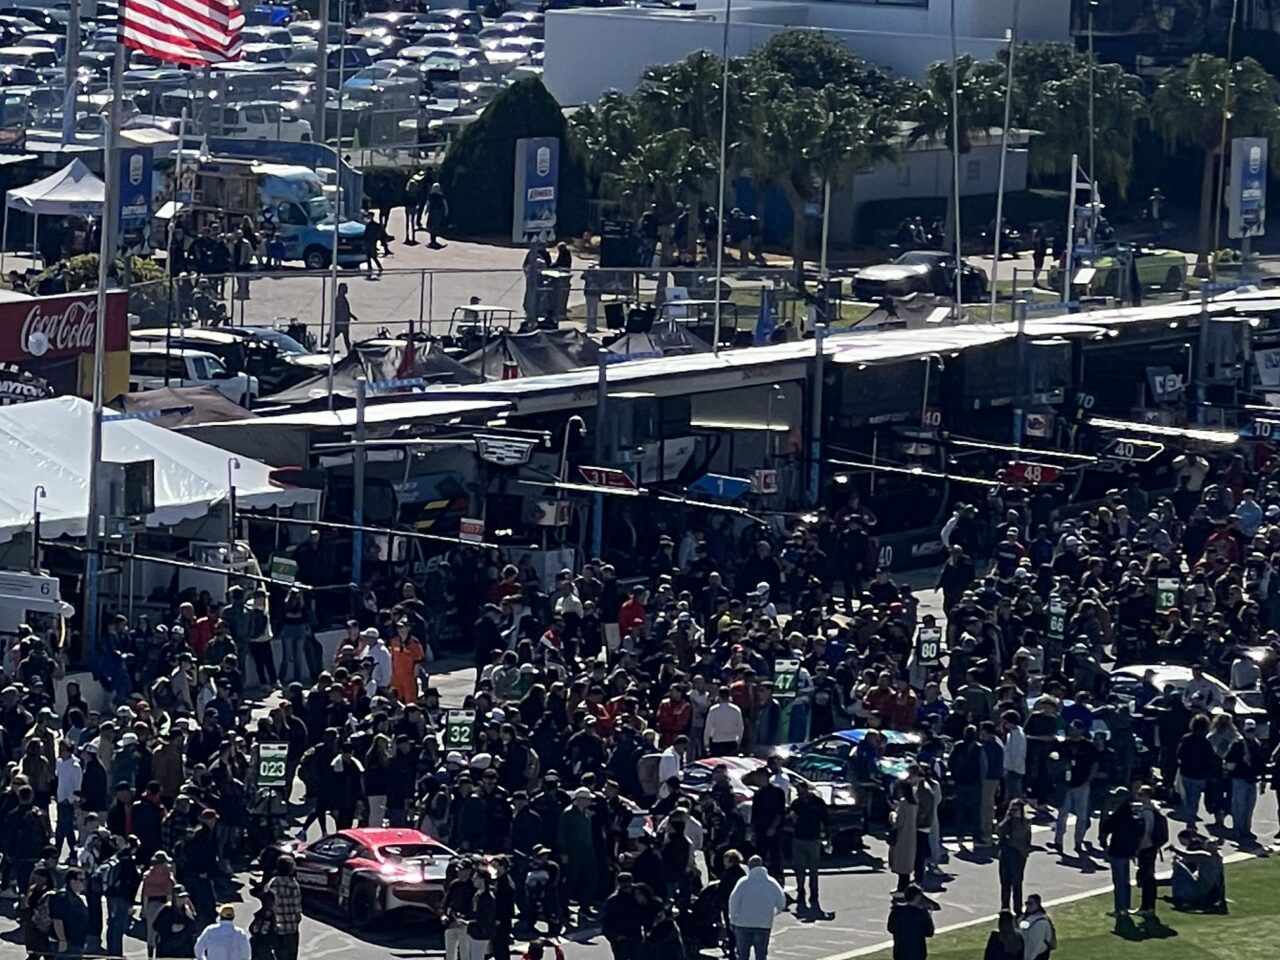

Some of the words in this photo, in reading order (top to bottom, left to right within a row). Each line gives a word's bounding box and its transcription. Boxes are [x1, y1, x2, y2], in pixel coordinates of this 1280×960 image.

[1077, 392, 1095, 409] 10
[1254, 422, 1271, 437] 10
[1114, 443, 1135, 457] 40
[591, 471, 607, 484] 31
[1024, 465, 1042, 482] 48
[878, 545, 893, 565] 40
[40, 582, 50, 595] 6
[1160, 592, 1175, 607] 13
[1050, 616, 1064, 632] 66
[921, 642, 937, 658] 80
[775, 674, 794, 689] 47
[450, 725, 471, 743] 32
[260, 761, 286, 777] 023
